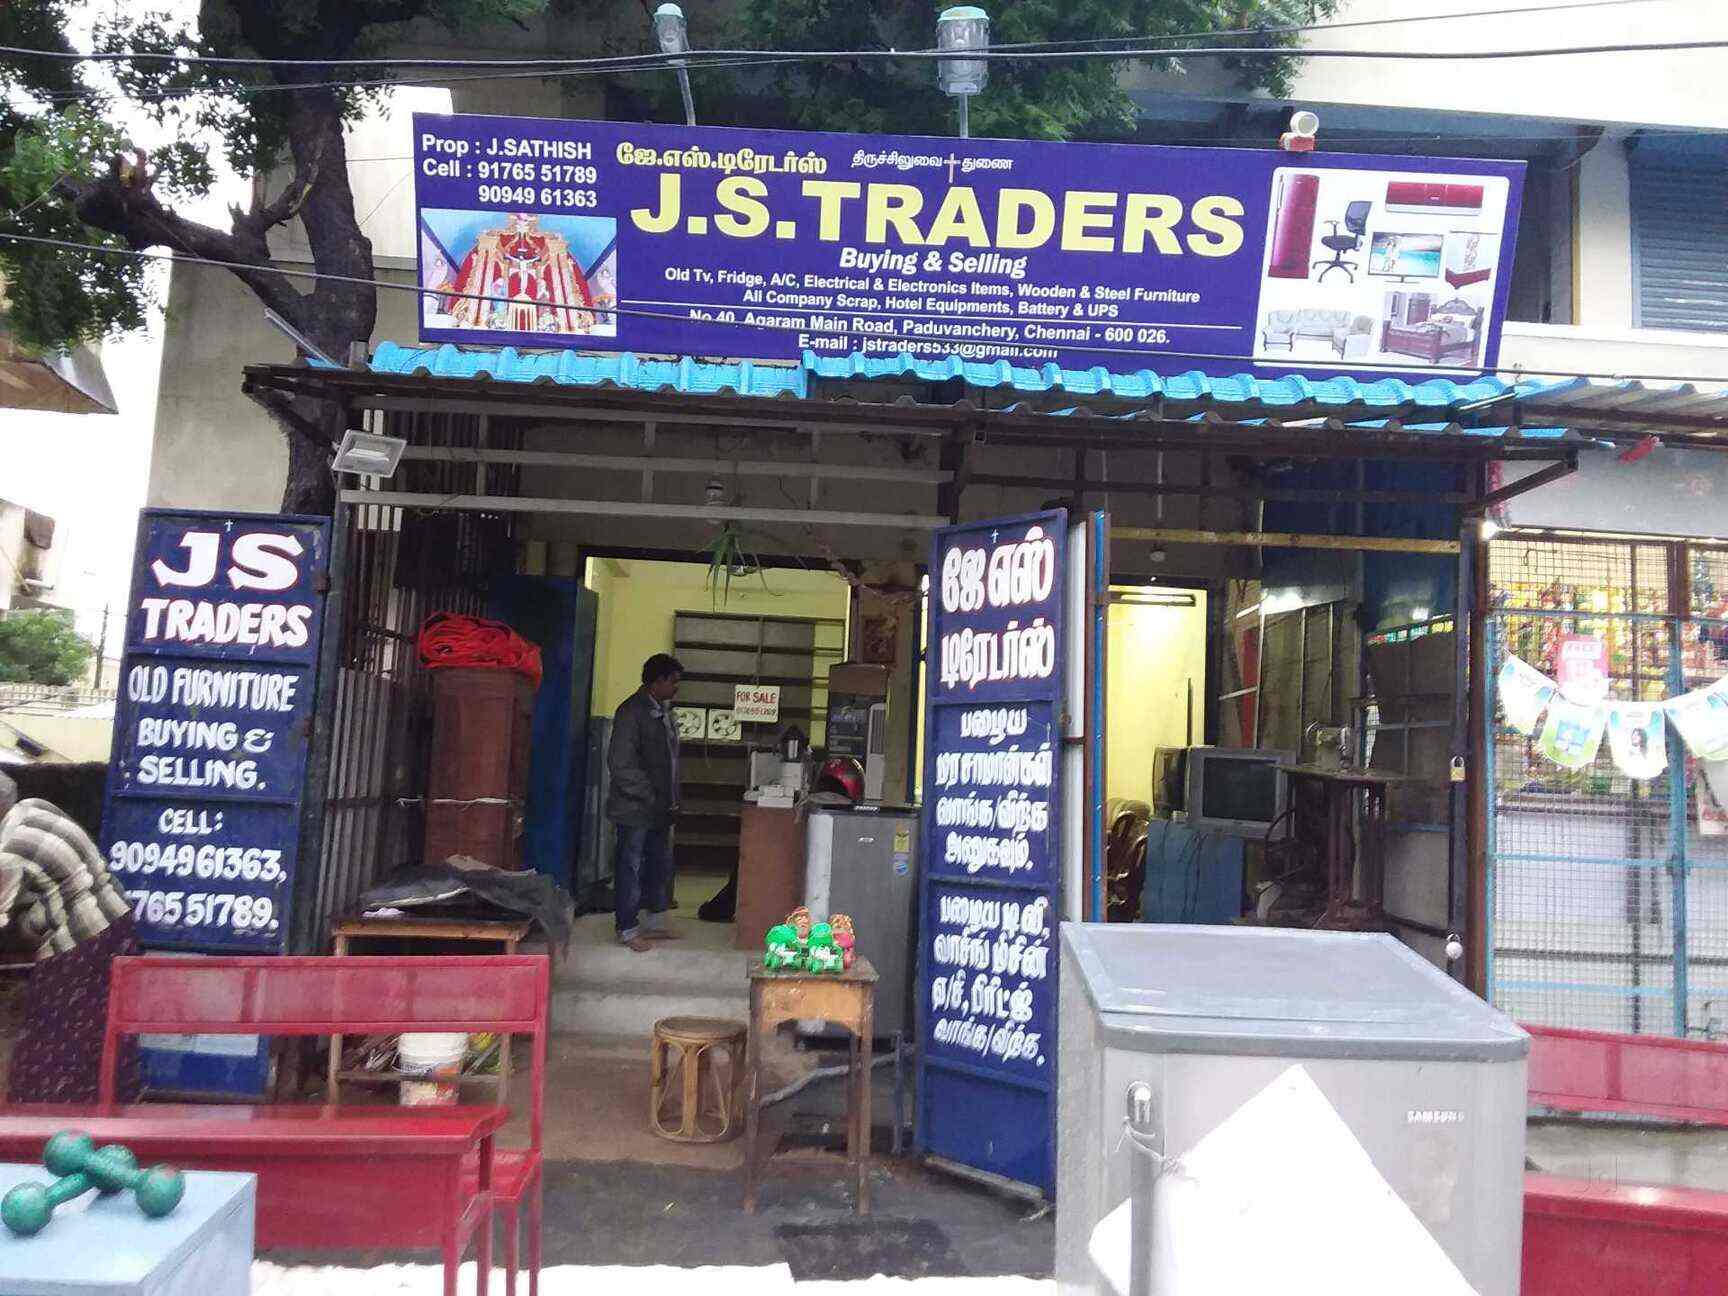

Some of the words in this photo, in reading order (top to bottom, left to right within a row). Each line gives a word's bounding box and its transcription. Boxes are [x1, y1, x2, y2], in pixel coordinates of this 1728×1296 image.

[422, 134, 469, 156] Prop
[486, 138, 592, 160] J.SATHISH
[423, 159, 460, 177] Cell
[478, 162, 535, 182] 91765
[541, 165, 597, 184] 51789
[479, 185, 535, 205] 90949
[541, 189, 597, 208] 61363
[840, 247, 918, 275] Buying
[923, 251, 943, 273] &
[948, 252, 1028, 279] Selling
[665, 267, 690, 282] Old
[693, 268, 714, 285] Tv,
[718, 269, 767, 288] Fridge,
[770, 273, 800, 289] A/C,
[804, 275, 869, 291] Electrical
[873, 278, 884, 291] &
[888, 278, 967, 295] Electronics
[970, 283, 1014, 299] Items,
[1018, 284, 1076, 299] Wooden
[1080, 286, 1090, 299] &
[1094, 286, 1131, 301] Steel
[1135, 288, 1200, 304] Furniture
[743, 289, 763, 303] All
[766, 291, 833, 309] Company
[837, 294, 880, 310] Scrap,
[885, 296, 922, 311] Hotel
[926, 299, 1014, 317] Equipments,
[1018, 301, 1069, 319] Battery
[1073, 303, 1084, 317] &
[1087, 303, 1119, 318] UPS
[799, 334, 848, 351] E-mail
[810, 315, 847, 331] Main
[852, 317, 898, 337] Road,
[902, 320, 1020, 341] Paduvanchery,
[1024, 324, 1090, 342] Chennai
[1105, 327, 1133, 343] 600
[1137, 328, 1170, 344] 026.
[141, 598, 313, 648] TRADERS
[128, 665, 168, 704] OLD
[172, 667, 300, 713] FURNITURE
[137, 716, 239, 751] BUYING
[137, 755, 266, 790] SELLING.
